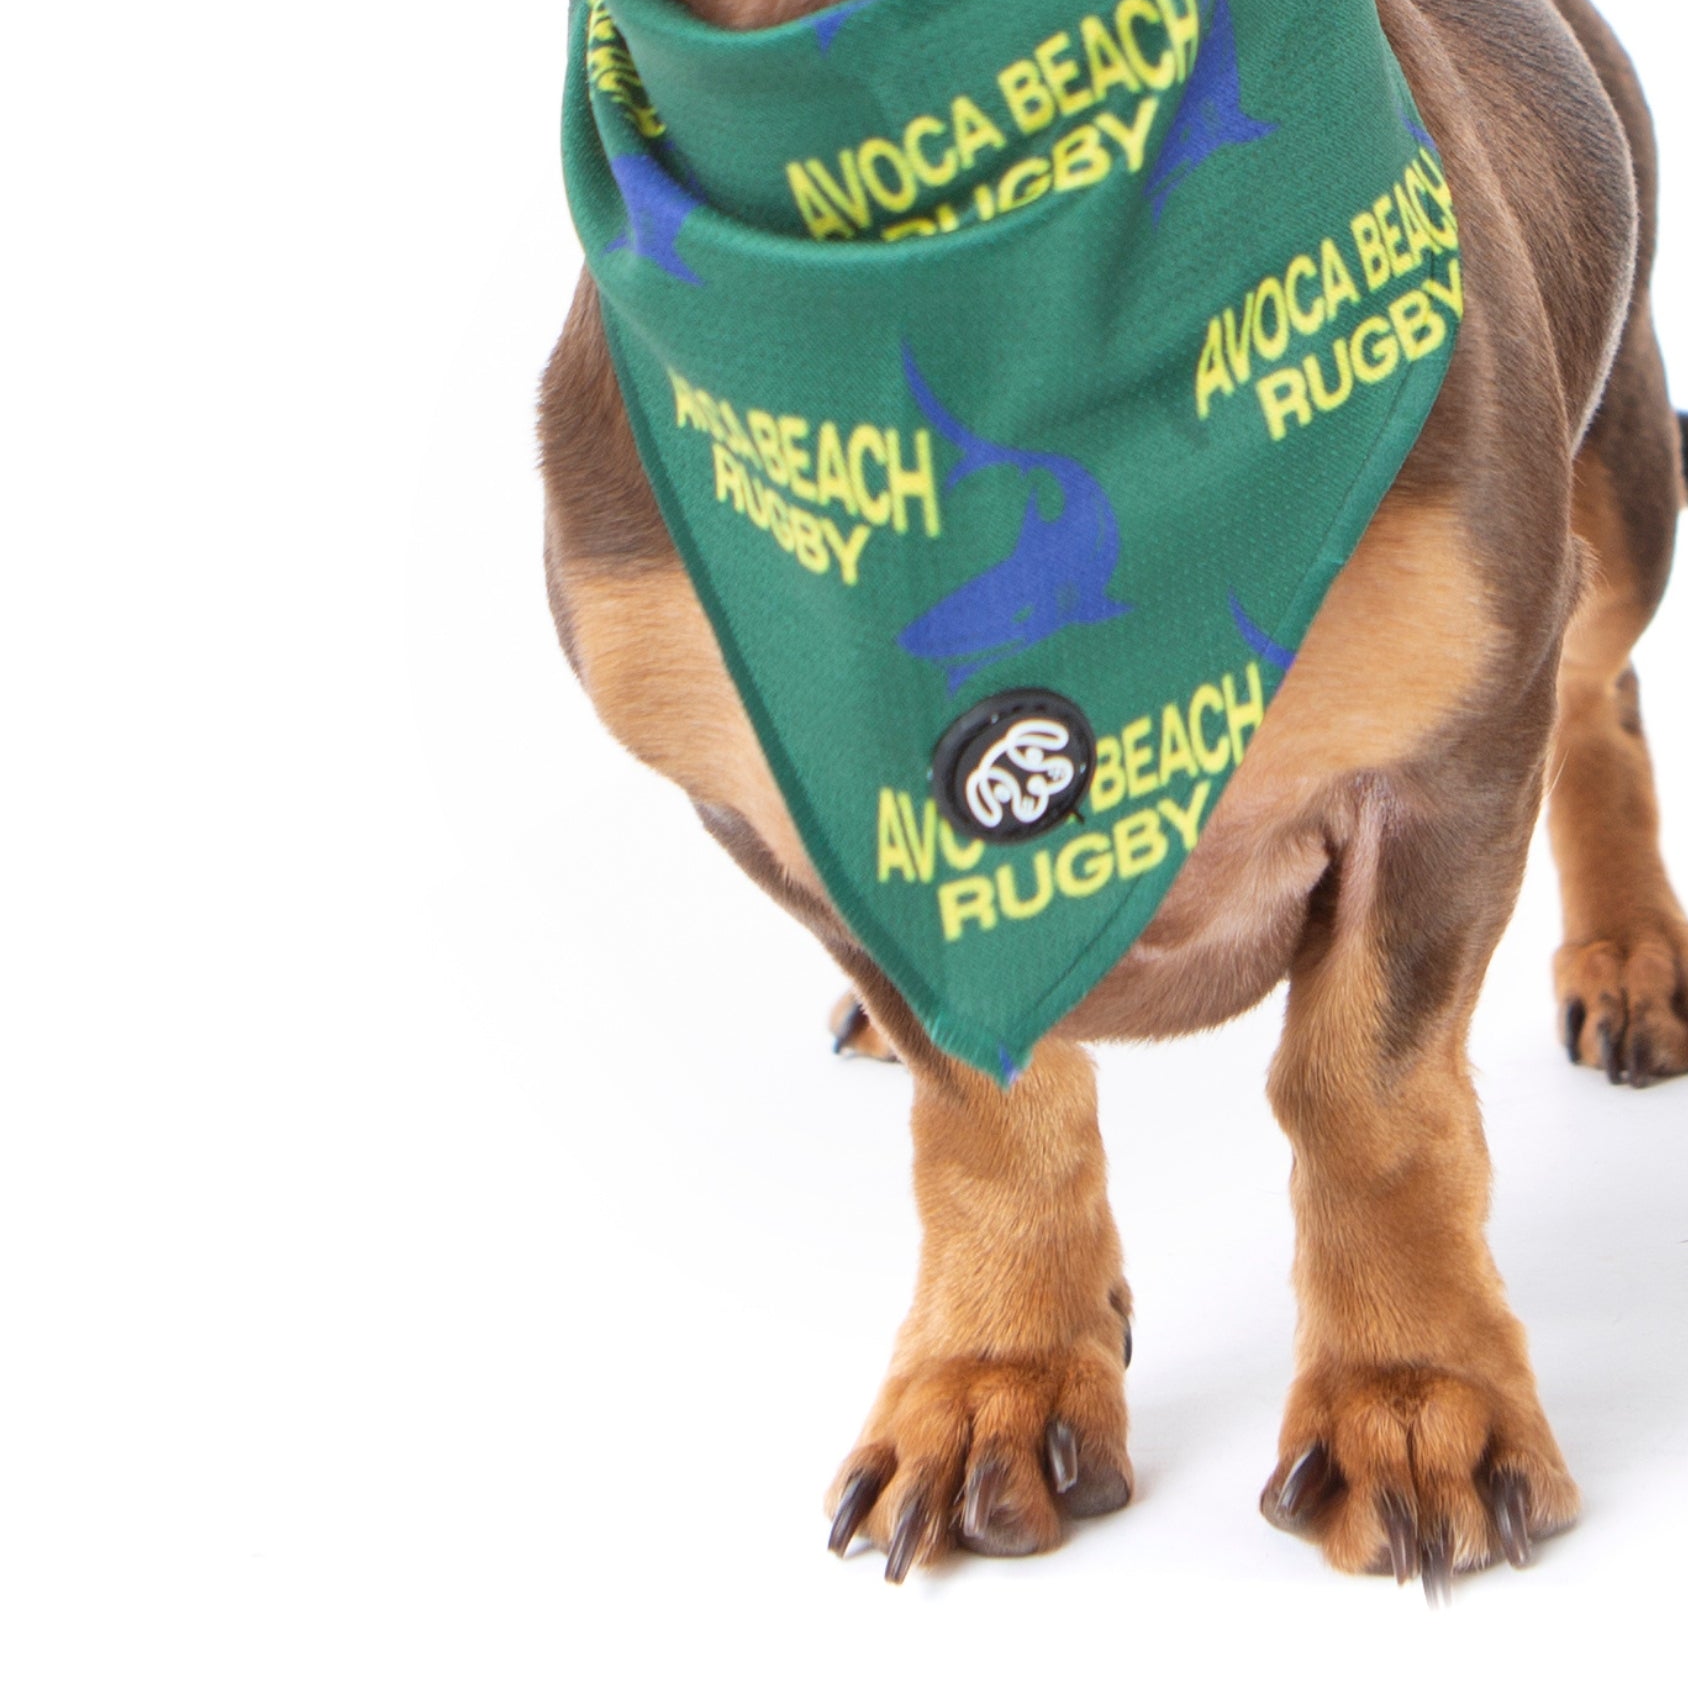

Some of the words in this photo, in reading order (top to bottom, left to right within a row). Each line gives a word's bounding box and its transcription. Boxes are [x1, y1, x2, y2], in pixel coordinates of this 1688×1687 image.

[786, 94, 1007, 240] AVOCA
[1195, 236, 1361, 421] AVOCA
[712, 441, 872, 587] RUGBY
[747, 408, 942, 538] BEACH
[1089, 662, 1264, 813] BEACH
[937, 781, 1211, 942] RUGBY
